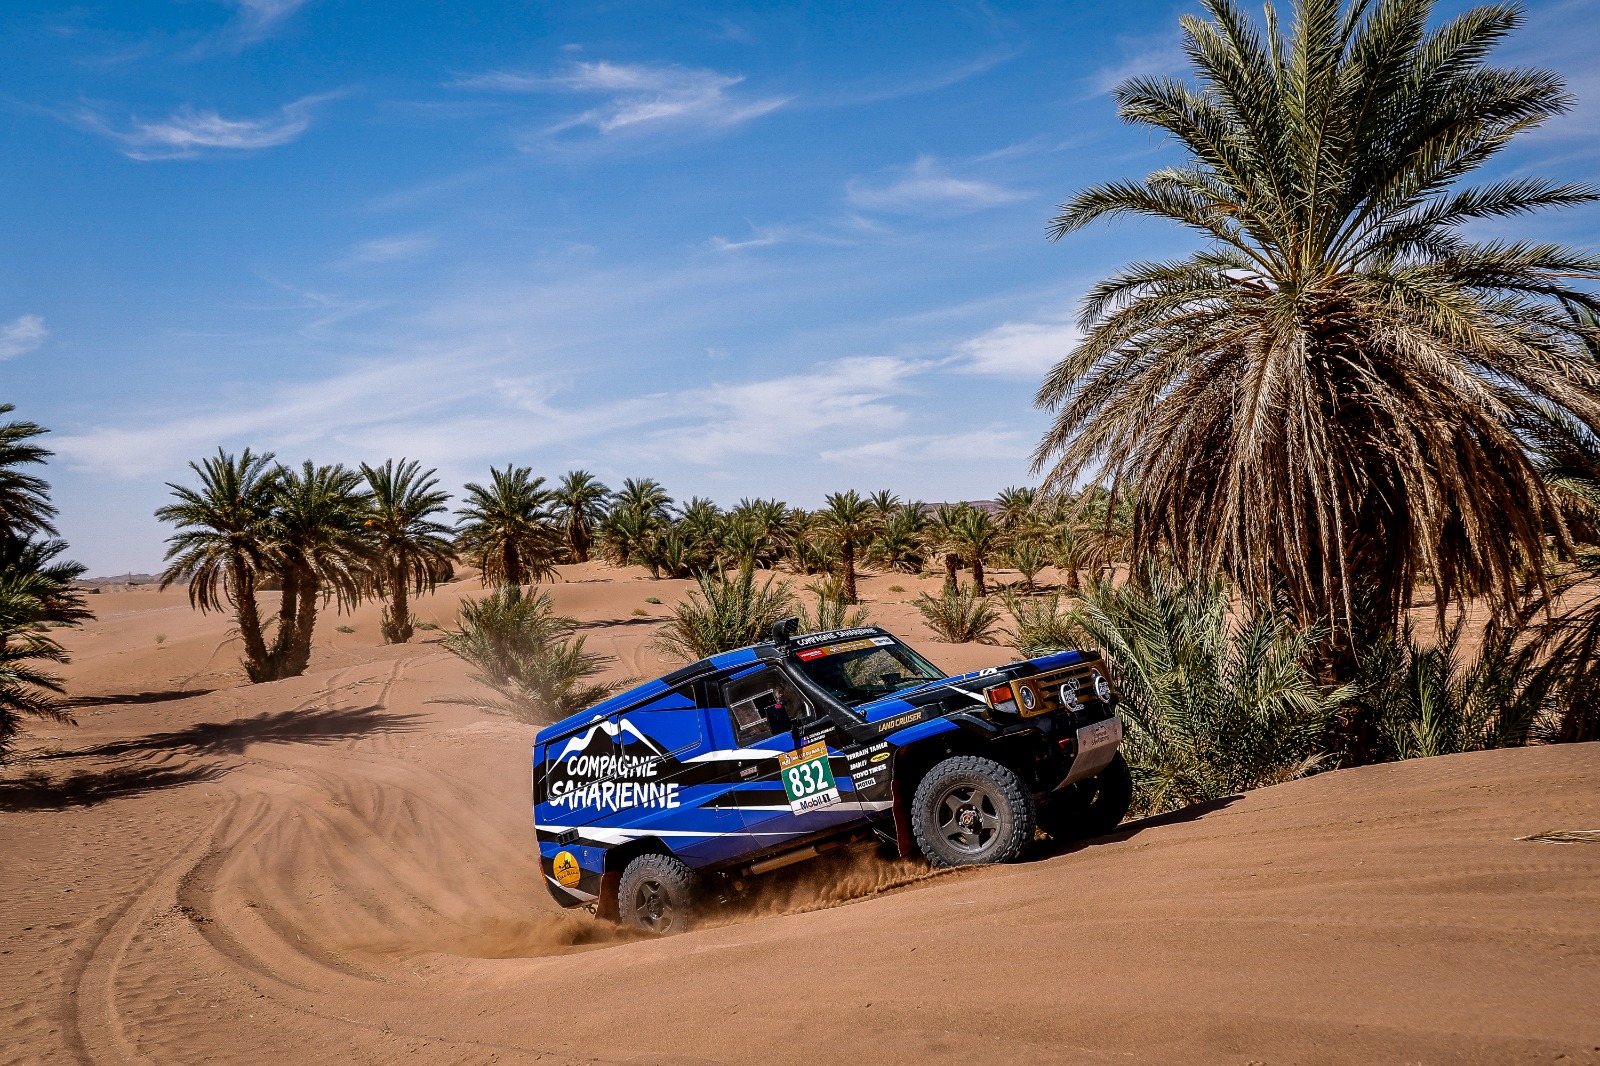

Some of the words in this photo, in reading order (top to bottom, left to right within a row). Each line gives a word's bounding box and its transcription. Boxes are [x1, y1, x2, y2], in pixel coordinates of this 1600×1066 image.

[878, 720, 895, 733] LAND
[895, 711, 922, 728] CRUISER
[567, 755, 658, 778] COMPAGNIE
[852, 769, 869, 780] TOYO
[789, 760, 829, 797] 832
[549, 780, 681, 812] SAHARIENNE
[800, 794, 823, 810] Mobil
